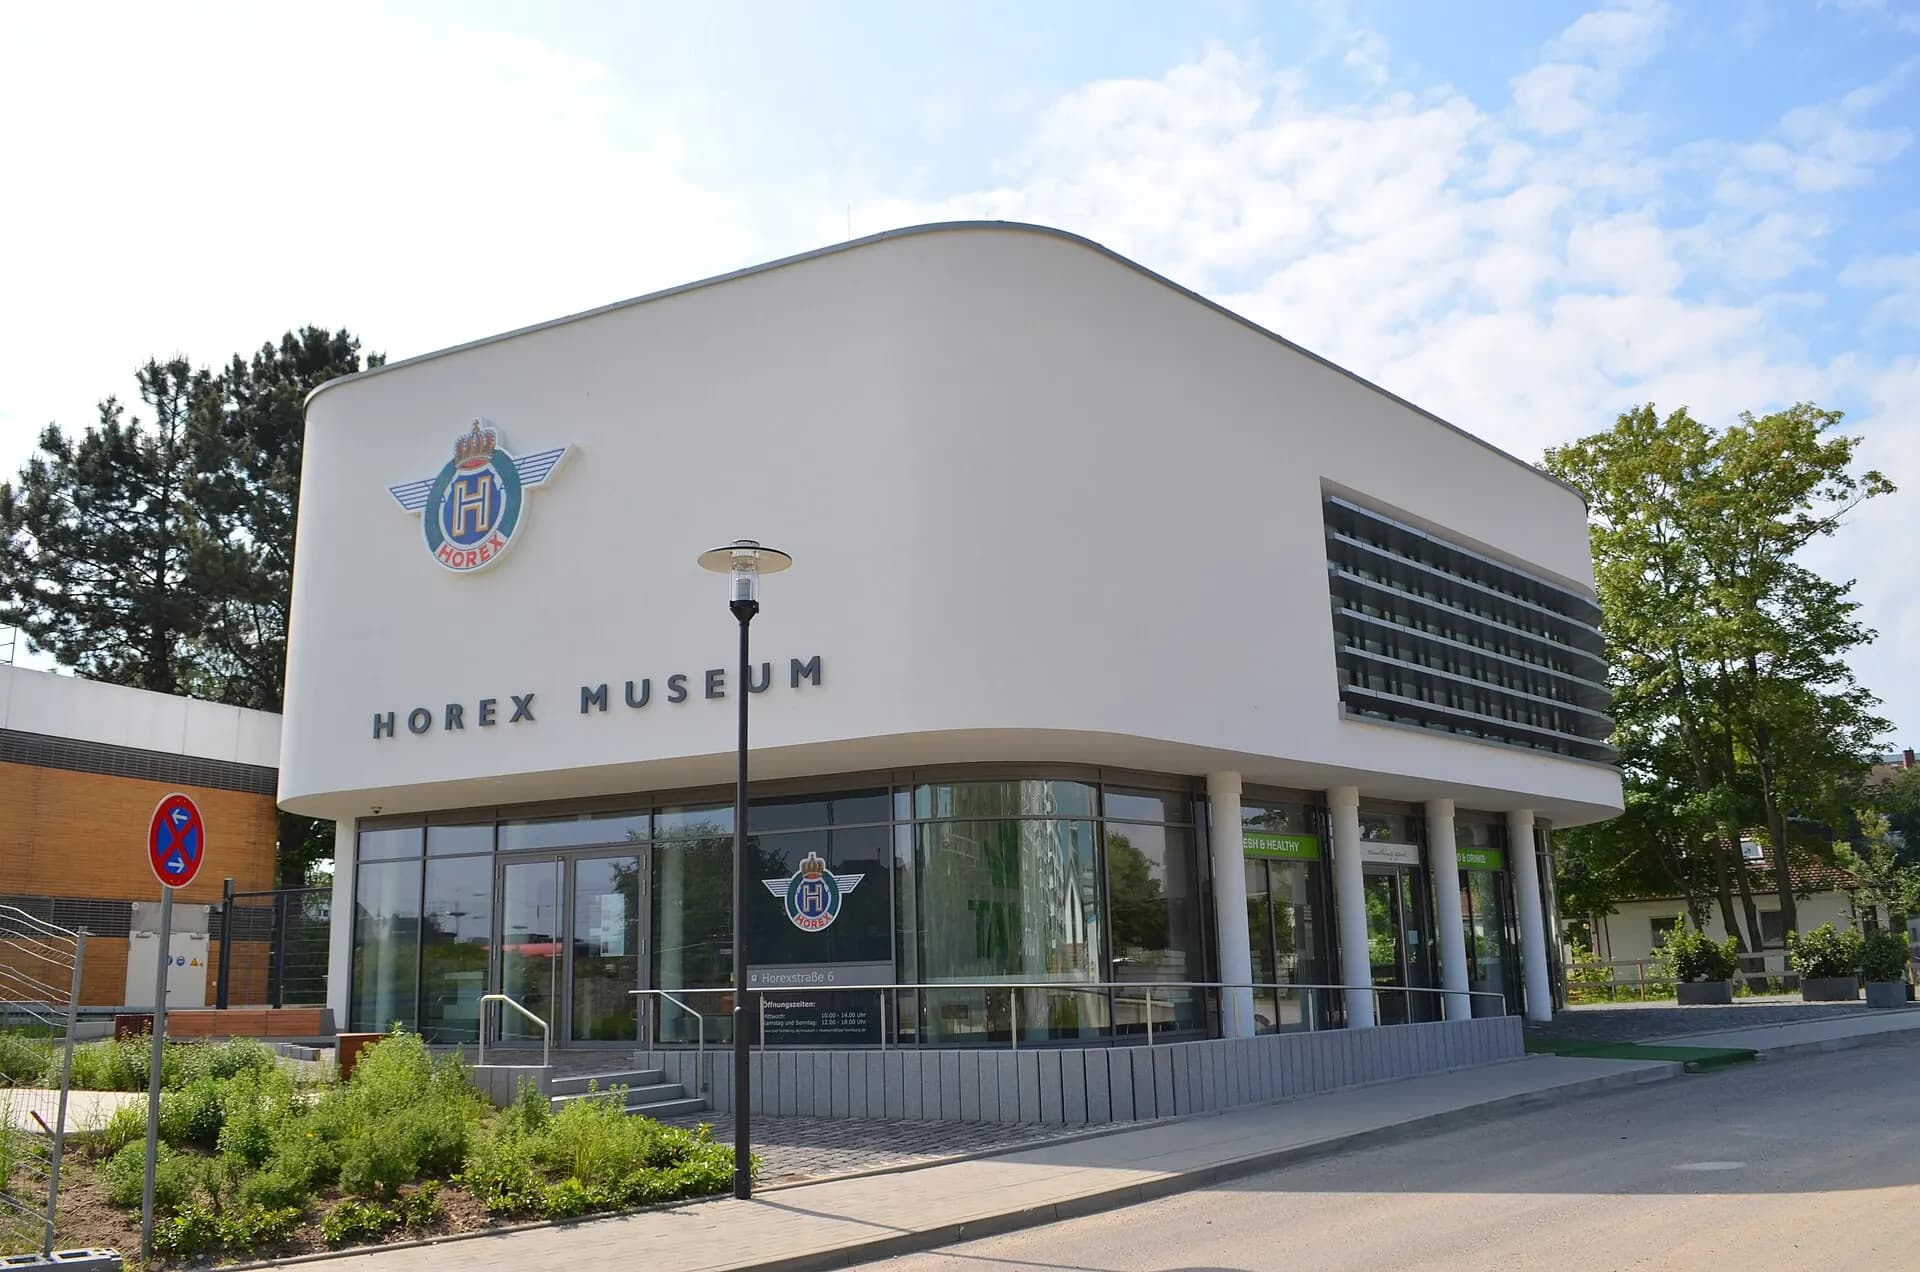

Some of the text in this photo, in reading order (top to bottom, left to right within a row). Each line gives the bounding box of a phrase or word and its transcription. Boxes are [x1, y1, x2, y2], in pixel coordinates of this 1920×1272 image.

[452, 475, 492, 537] H
[438, 534, 504, 567] HOREX
[372, 655, 822, 739] HOREX MUSEUM
[1267, 840, 1300, 852] HEALTHY
[802, 884, 822, 912] H
[795, 912, 831, 928] HOREX
[762, 971, 834, 984] Horexstraße 6
